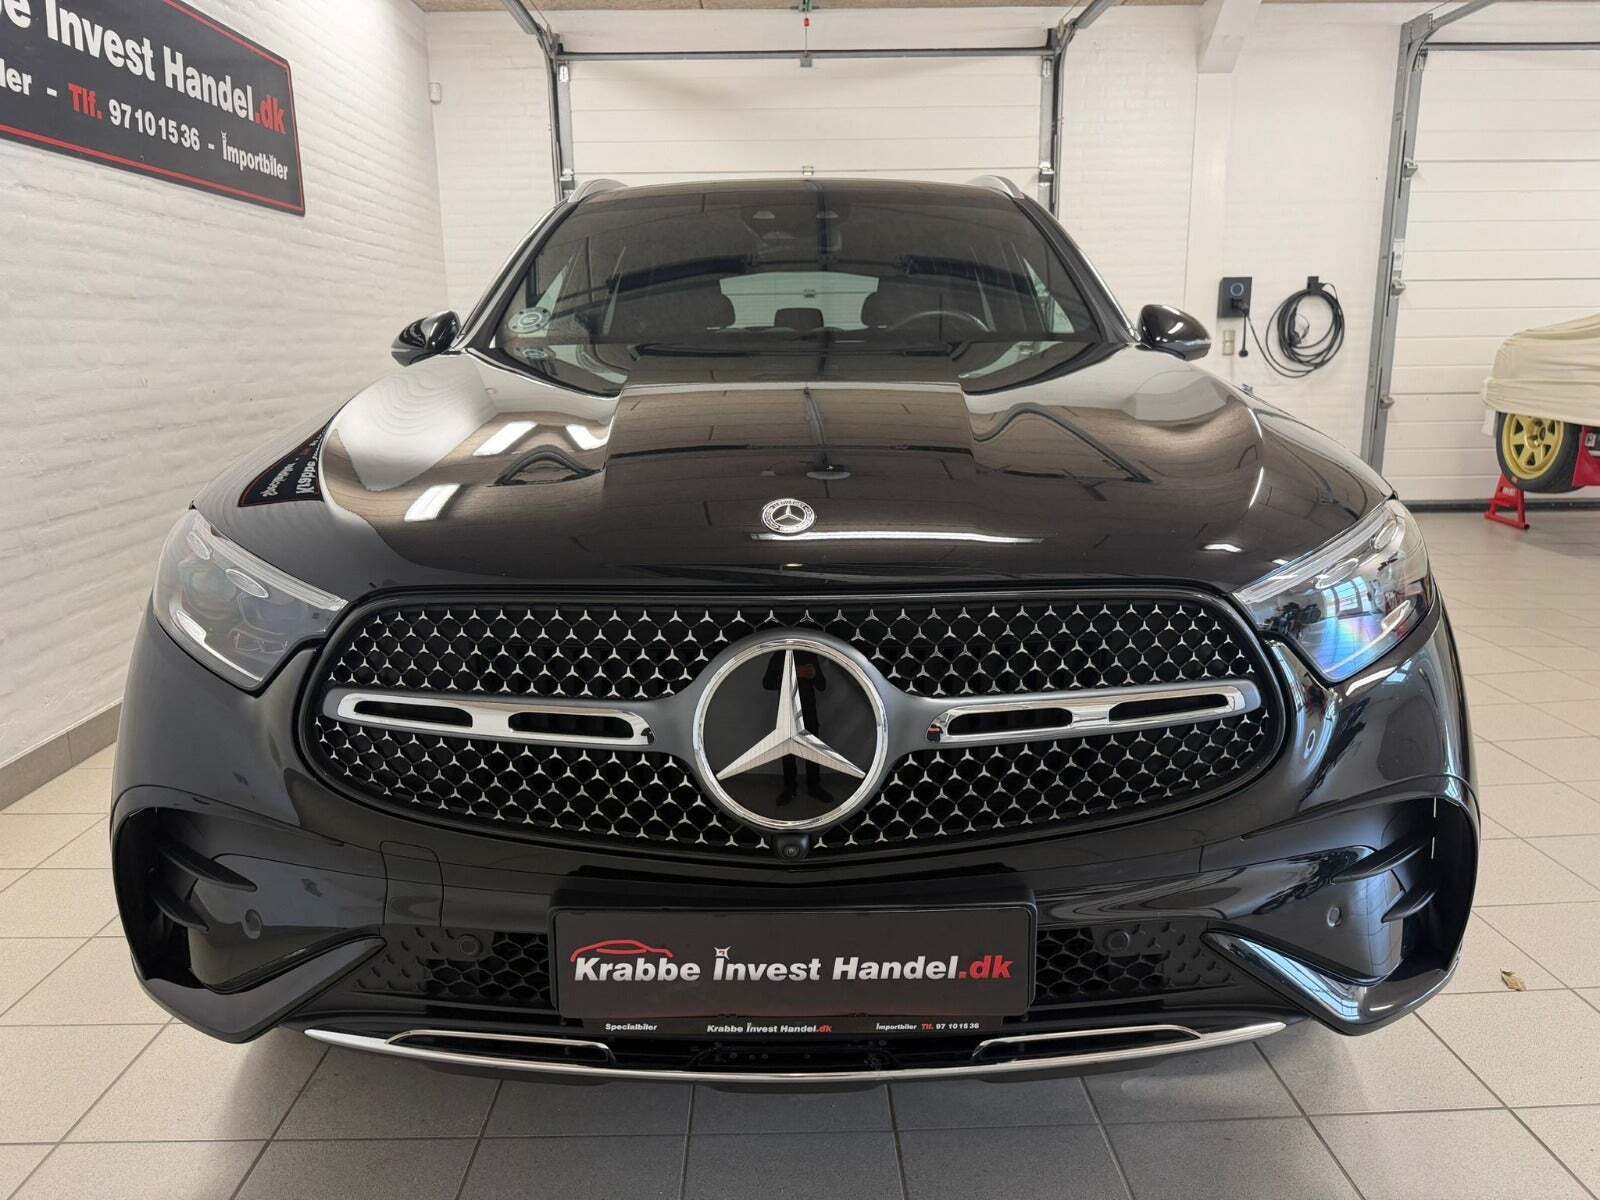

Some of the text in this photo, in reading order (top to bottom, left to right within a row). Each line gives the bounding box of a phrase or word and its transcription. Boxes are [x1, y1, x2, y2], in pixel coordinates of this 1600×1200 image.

[45, 0, 155, 81] Invest
[163, 45, 287, 134] Handel.dk
[68, 82, 104, 120] Tlf.
[220, 131, 288, 180] Importbiler
[574, 950, 1013, 982] Krabbe Invest Handel.dk
[604, 1022, 658, 1032] Specialbiler
[706, 1023, 832, 1033] Krabbe Invest Handel.dk
[875, 1022, 917, 1032] Importbiler
